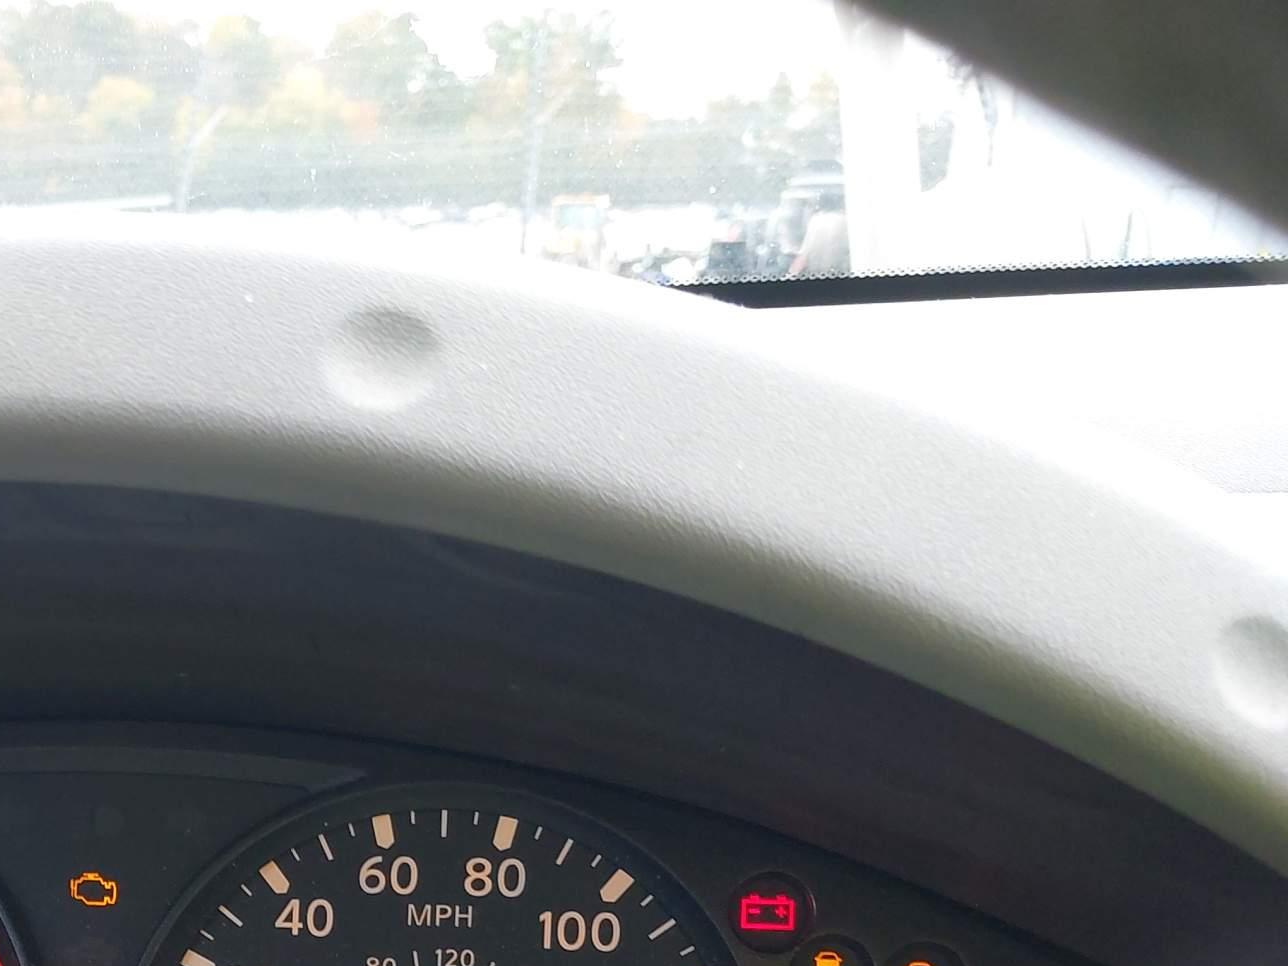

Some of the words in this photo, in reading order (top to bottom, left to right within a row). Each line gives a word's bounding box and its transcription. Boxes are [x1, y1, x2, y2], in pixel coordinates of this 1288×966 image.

[358, 856, 419, 897] 60
[463, 857, 527, 898] 80
[274, 899, 335, 937] 40
[406, 904, 474, 928] MPH
[538, 910, 622, 952] 100
